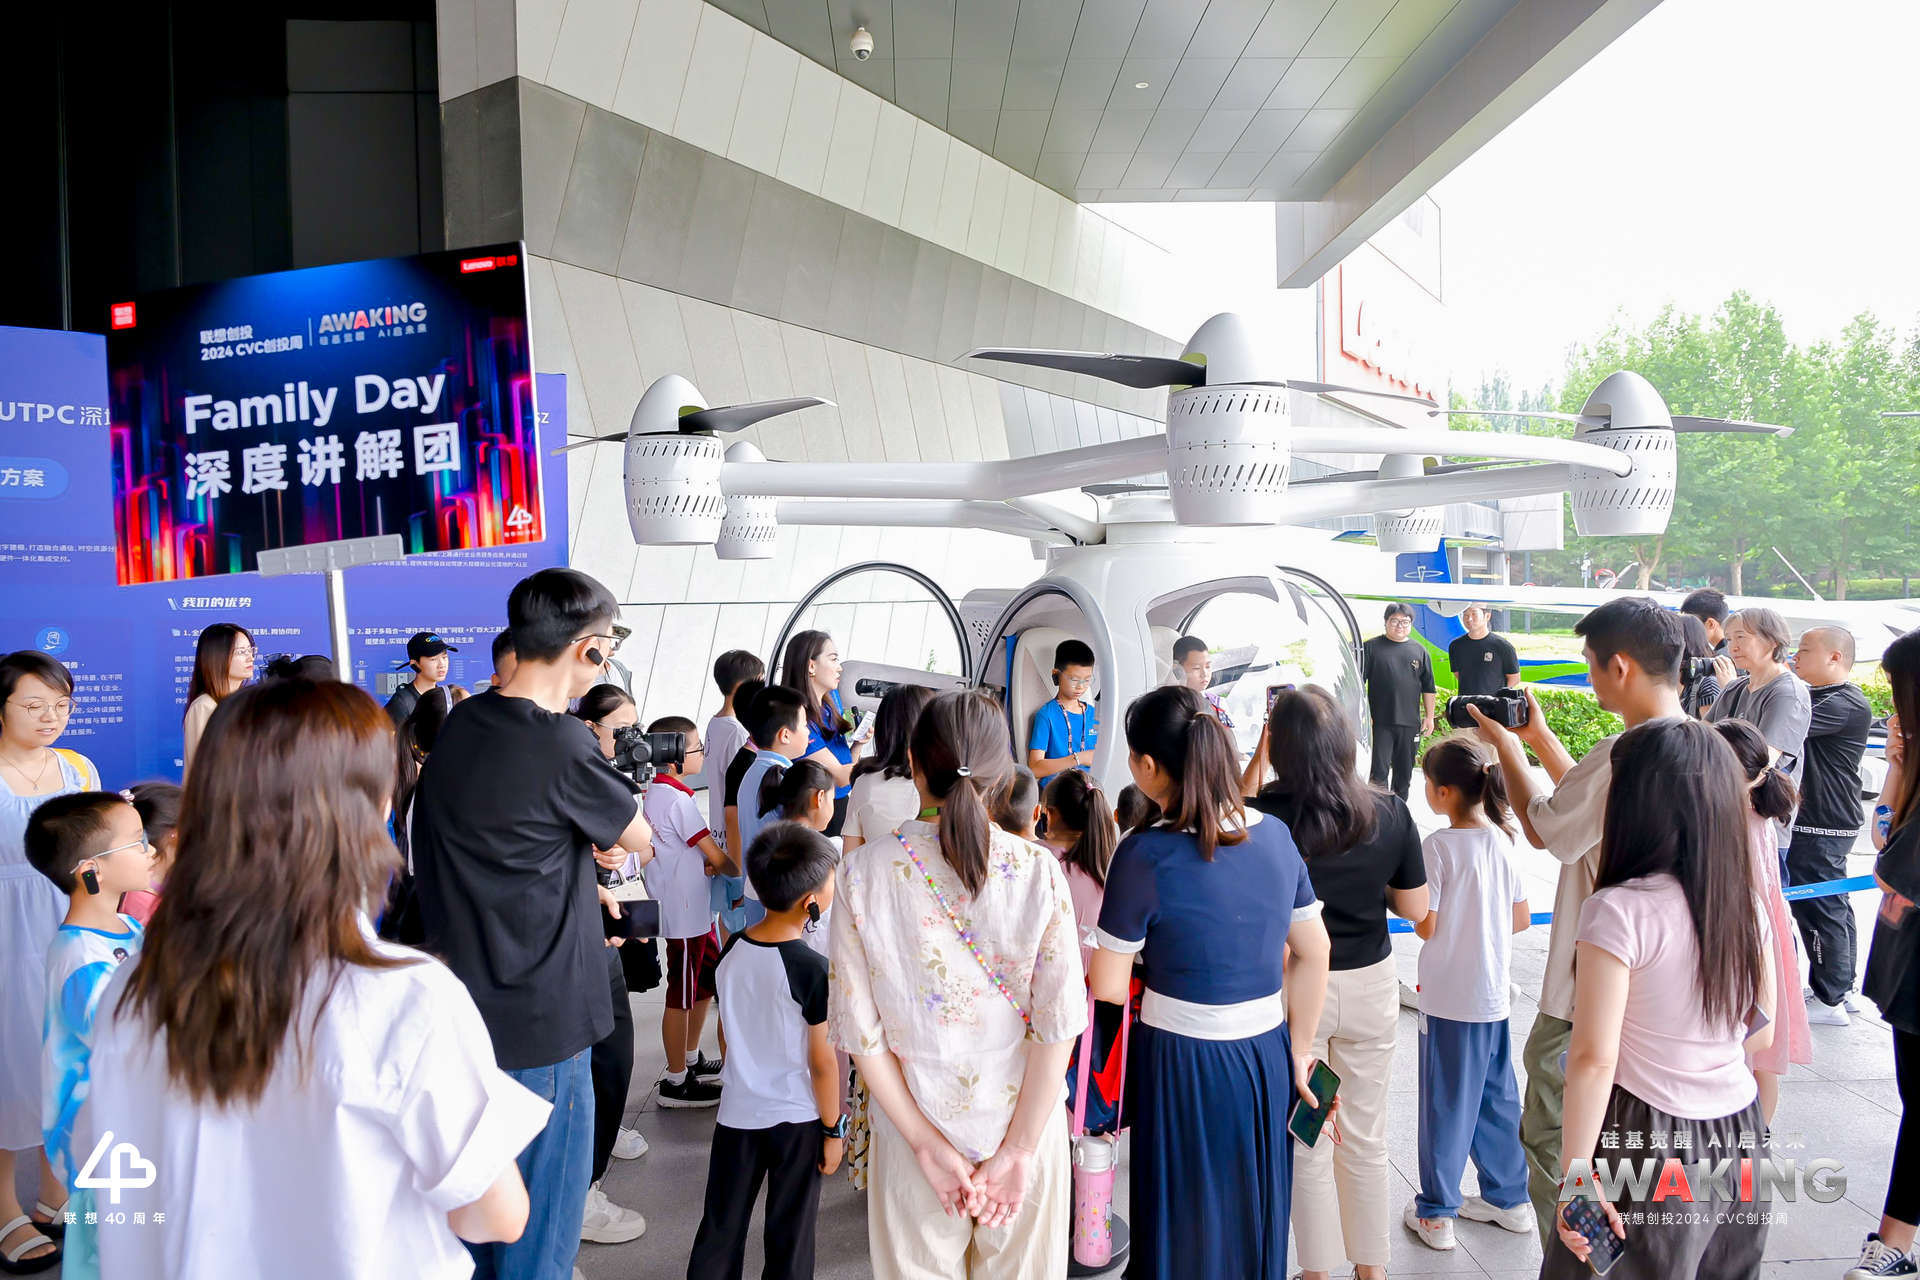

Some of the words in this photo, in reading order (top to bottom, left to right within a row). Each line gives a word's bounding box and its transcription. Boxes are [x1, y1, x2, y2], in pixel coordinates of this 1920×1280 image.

[318, 301, 428, 334] AWAKING
[200, 345, 234, 361] 2024
[184, 381, 339, 434] Family
[355, 372, 447, 414] Day
[184, 421, 463, 501] 深度讲解团
[1, 468, 46, 488] 方案
[182, 595, 252, 609] 我们的优势
